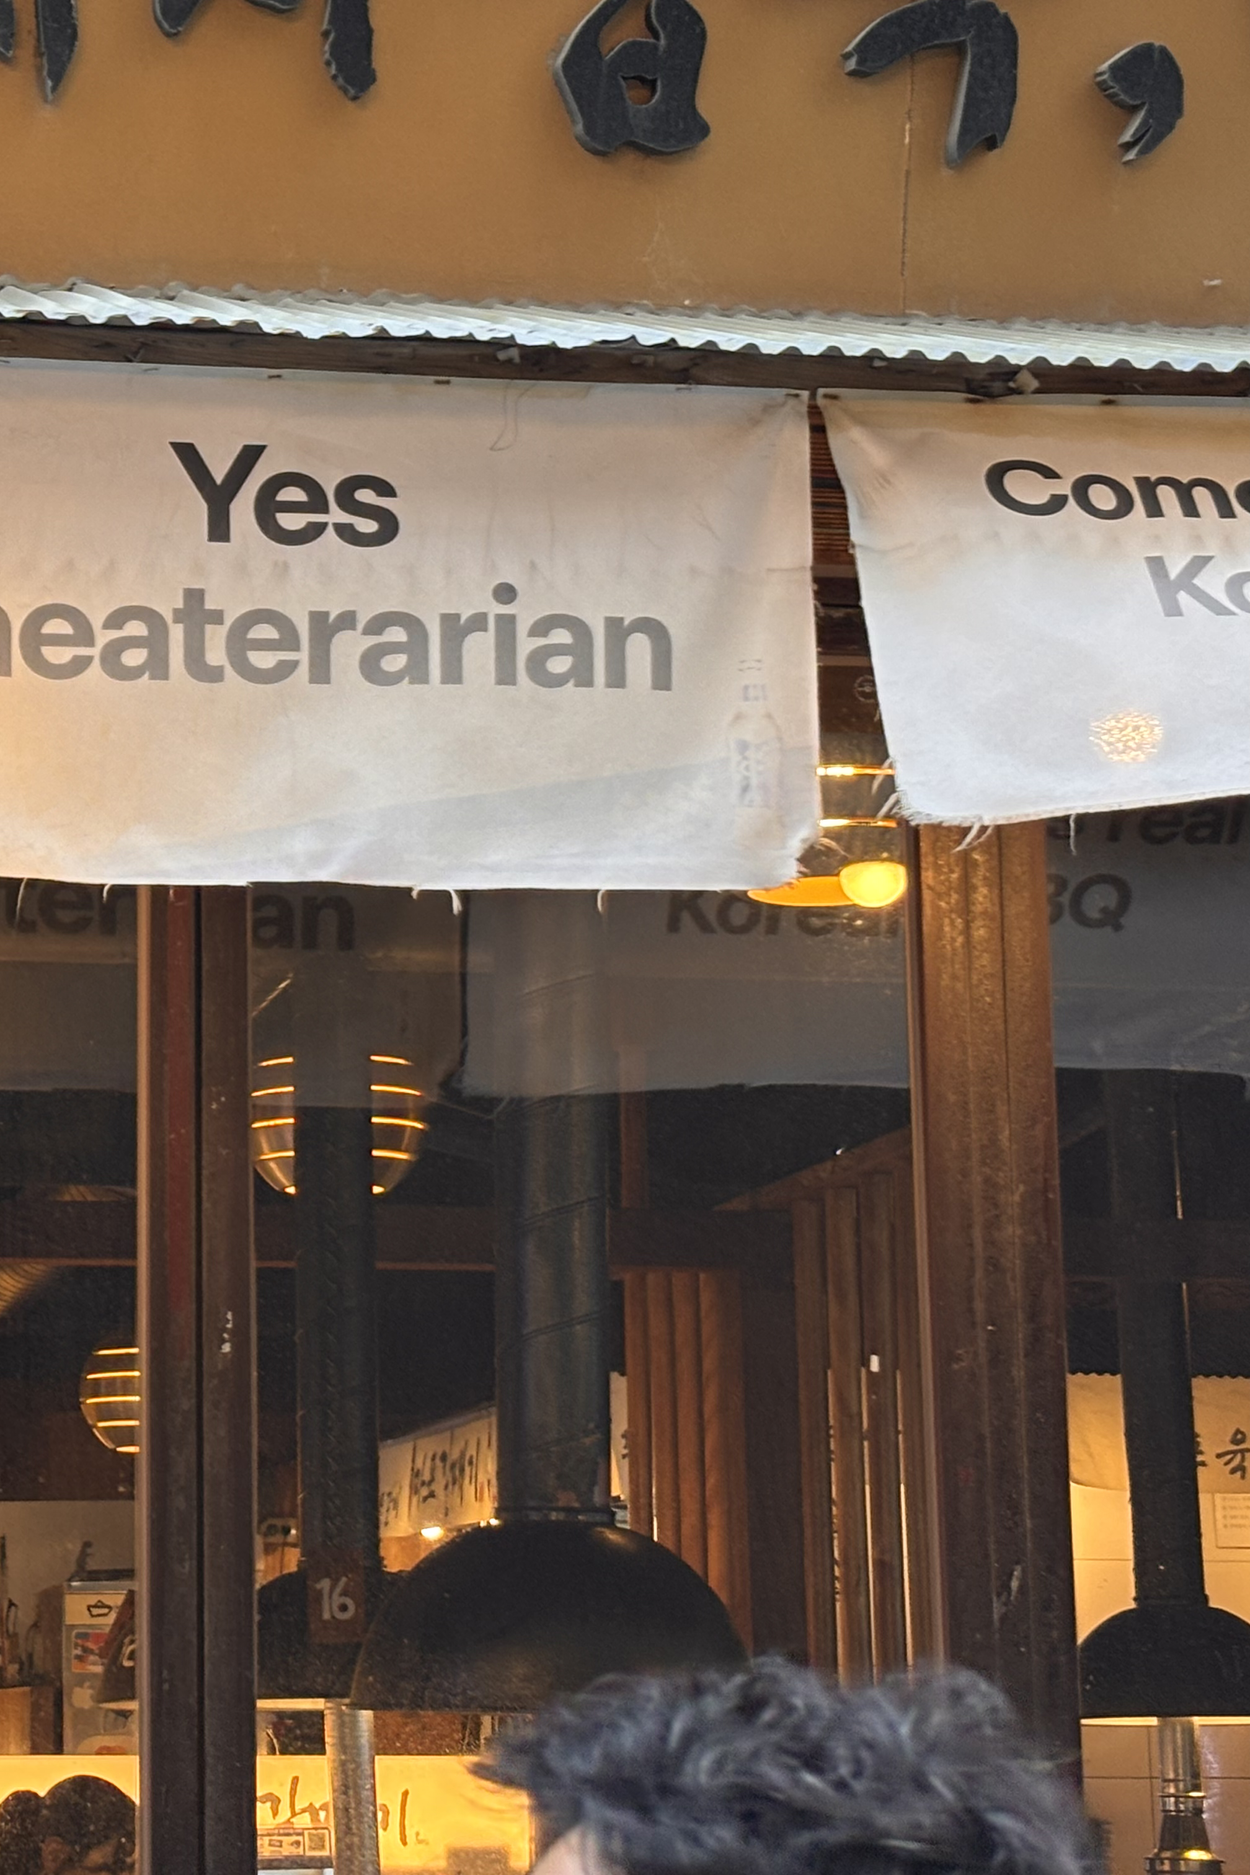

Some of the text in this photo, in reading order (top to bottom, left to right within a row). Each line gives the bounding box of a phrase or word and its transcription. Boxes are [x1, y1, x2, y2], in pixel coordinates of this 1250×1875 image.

[169, 441, 400, 547] Yes
[984, 459, 1250, 520] Com
[315, 1576, 356, 1620] 16
